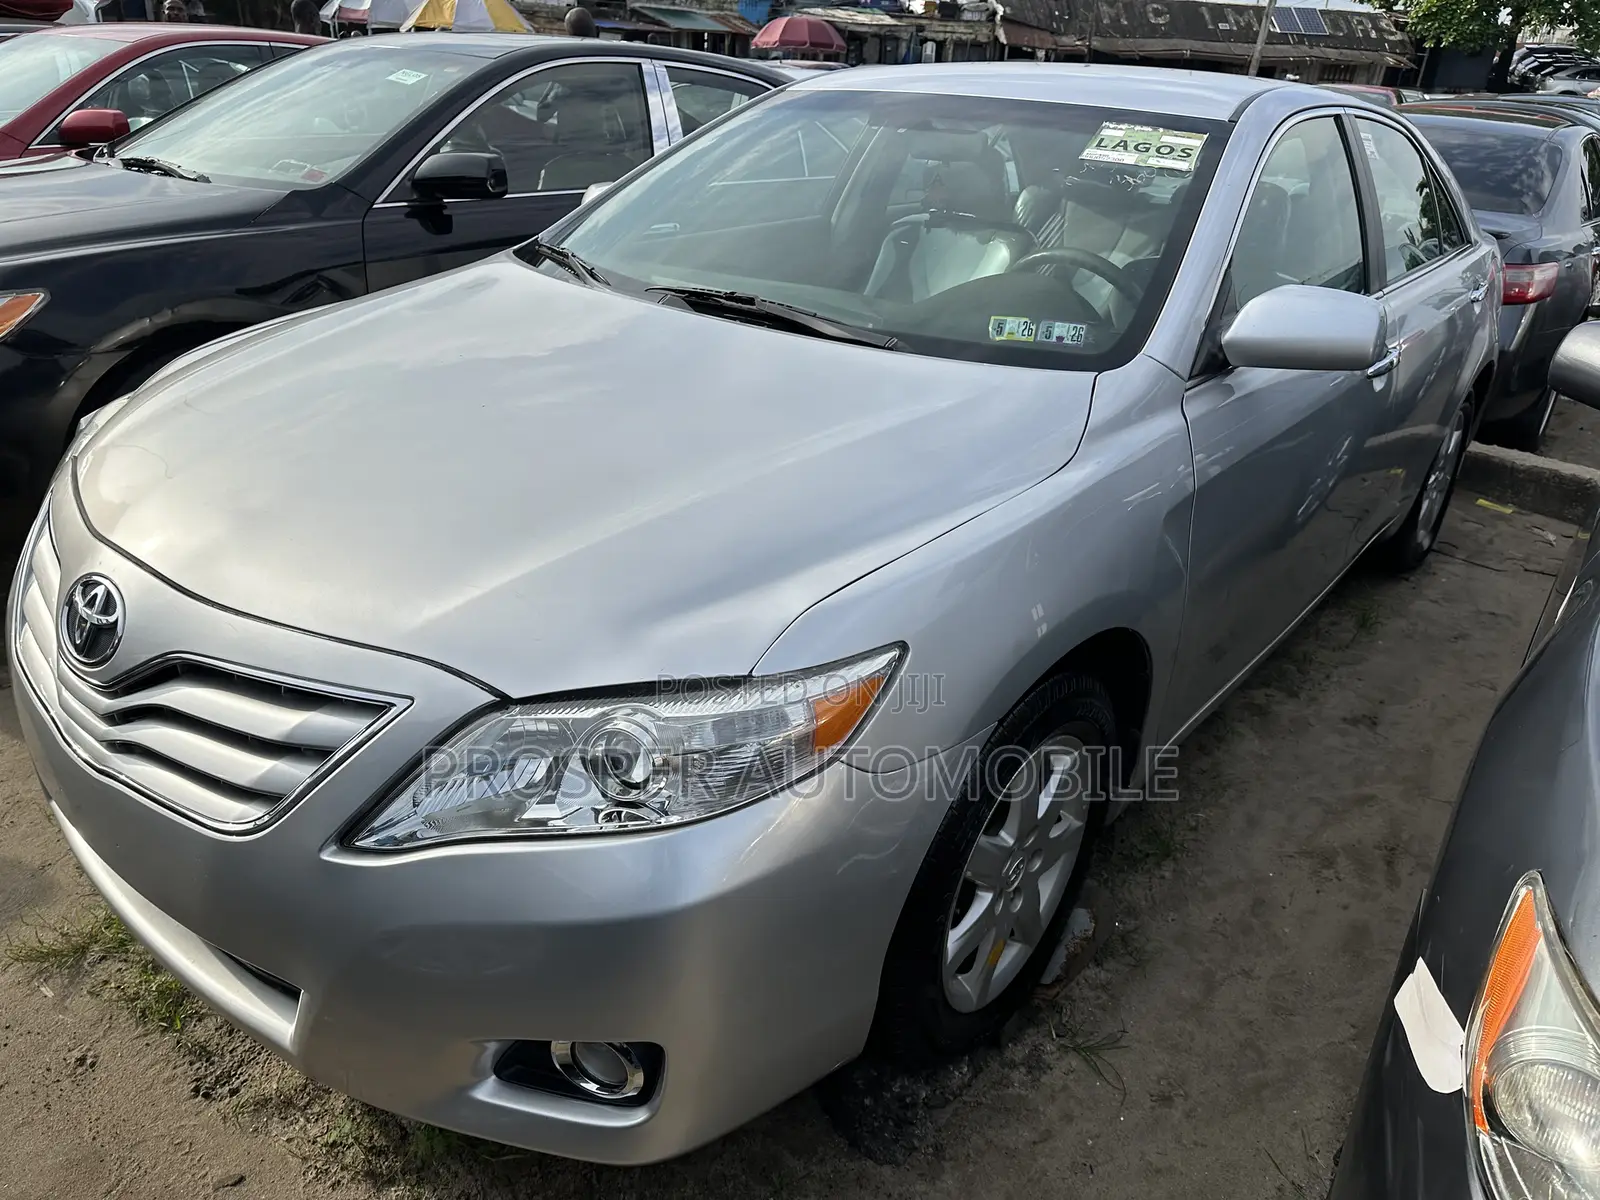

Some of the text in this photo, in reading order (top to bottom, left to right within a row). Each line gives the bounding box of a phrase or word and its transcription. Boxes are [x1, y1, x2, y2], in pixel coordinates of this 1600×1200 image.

[1095, 137, 1194, 159] LAGOS
[1021, 320, 1035, 337] 26
[1070, 325, 1084, 343] 26
